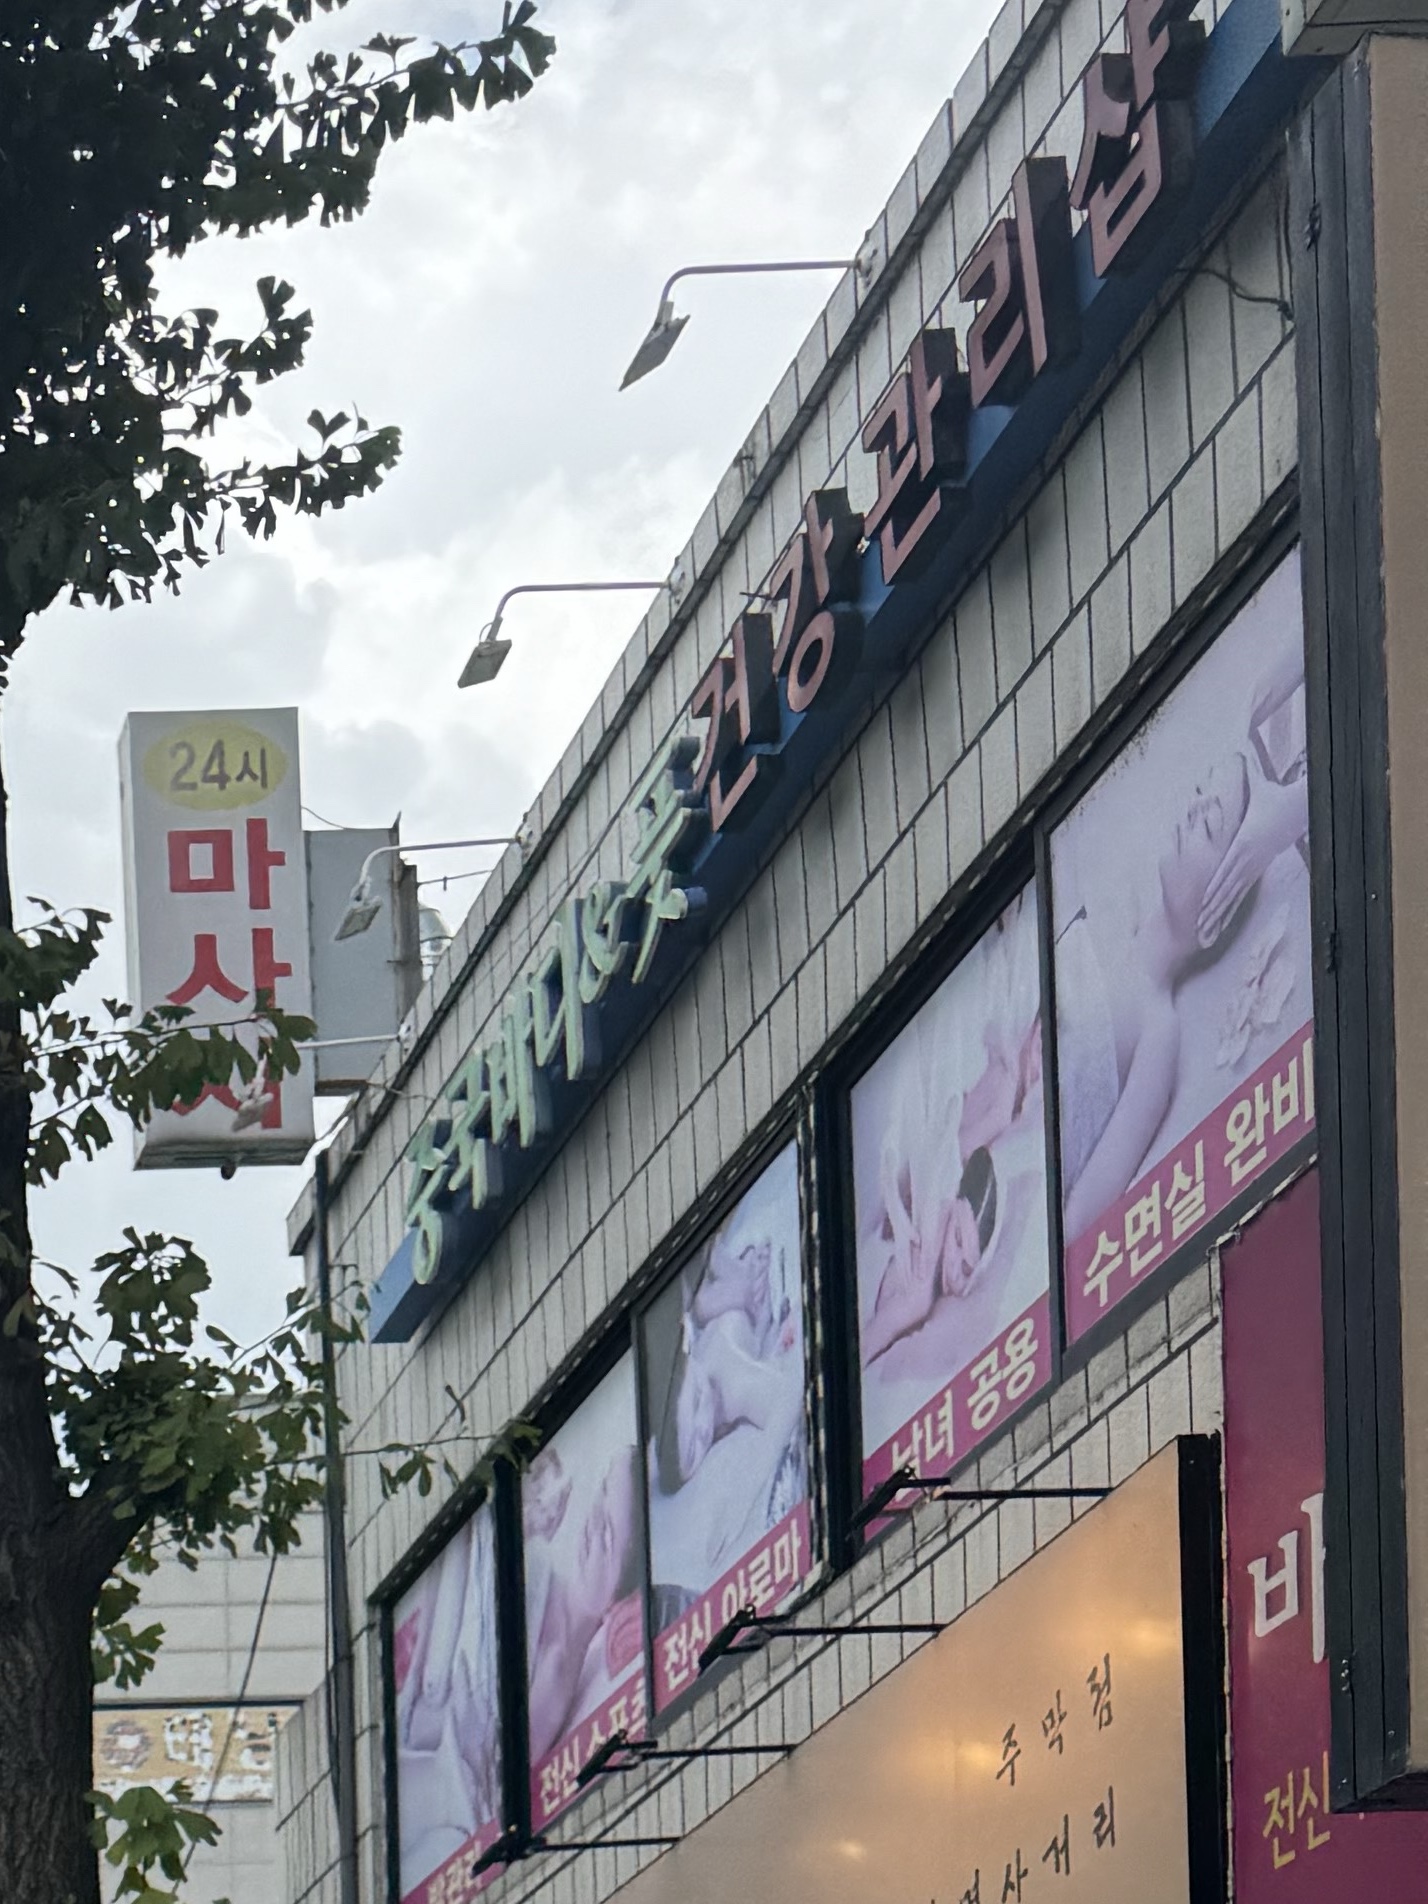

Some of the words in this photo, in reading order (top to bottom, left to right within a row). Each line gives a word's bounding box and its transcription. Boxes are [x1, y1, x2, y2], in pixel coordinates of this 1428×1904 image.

[699, 0, 1177, 833] 건강관리샵
[168, 740, 269, 791] 24시
[1083, 1140, 1205, 1305] 수면실
[1224, 1036, 1315, 1187] 완비
[969, 1317, 1038, 1431] 공용
[662, 1610, 711, 1691] 전신
[1261, 1750, 1331, 1871] 전신
